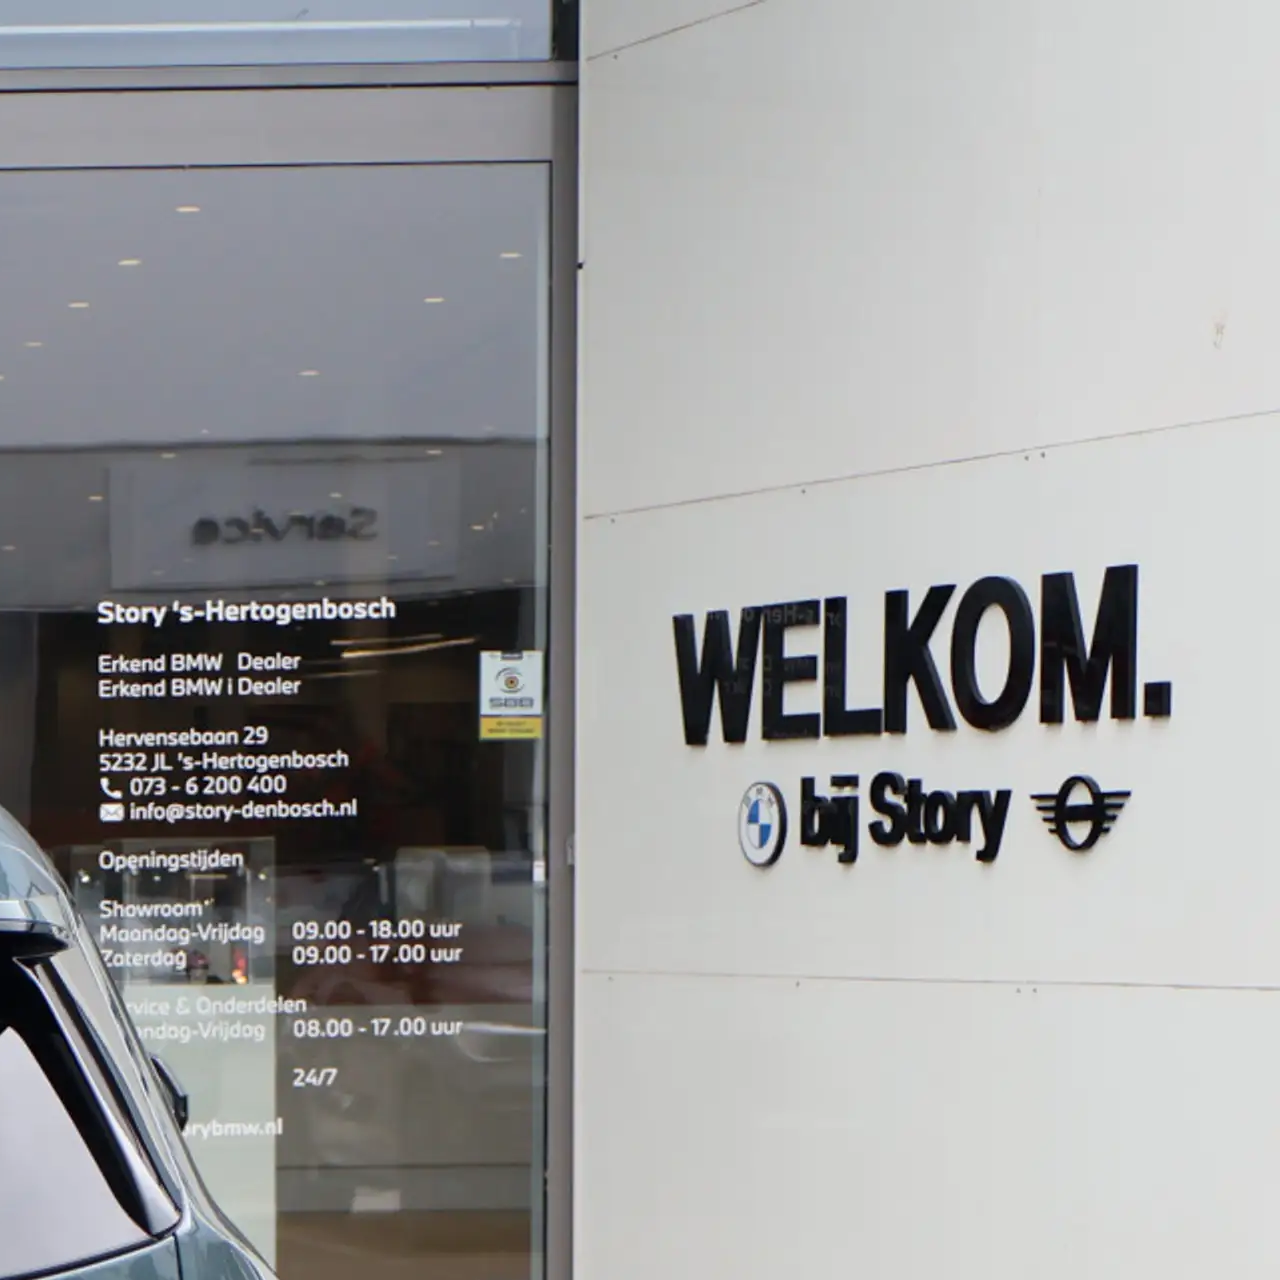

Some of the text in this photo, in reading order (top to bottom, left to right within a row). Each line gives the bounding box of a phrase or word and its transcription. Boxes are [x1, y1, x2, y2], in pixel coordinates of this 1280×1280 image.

[97, 600, 168, 628] Story
[98, 652, 302, 674] Erkend BMW Dealer
[673, 563, 1172, 745] WELKOM.
[98, 676, 302, 698] Erkend BMW i Dealer
[99, 725, 269, 748] Hervensebaan 29
[99, 752, 148, 772] 5232
[150, 752, 174, 773] JL
[129, 776, 167, 796] 073
[185, 776, 199, 796] 6
[202, 775, 243, 795] 200
[246, 774, 287, 794] 400
[129, 798, 357, 824] info@story-denbosch.nl
[800, 773, 859, 863] bij
[868, 772, 1012, 863] Story
[98, 849, 244, 876] Openingstijden
[99, 901, 203, 919] Showroom
[99, 924, 265, 945] Maandag-Vrijdag
[292, 920, 352, 941] 09.00
[369, 919, 425, 939] 18.00
[429, 923, 463, 938] uur
[102, 949, 187, 969] Zaterdag
[292, 944, 352, 965] 09.00
[430, 947, 463, 963] uur
[175, 996, 191, 1016] &
[196, 995, 307, 1014] Onderdelen
[293, 1018, 354, 1038] 08.00
[431, 1019, 463, 1036] uur
[293, 1067, 338, 1087] 24/7
